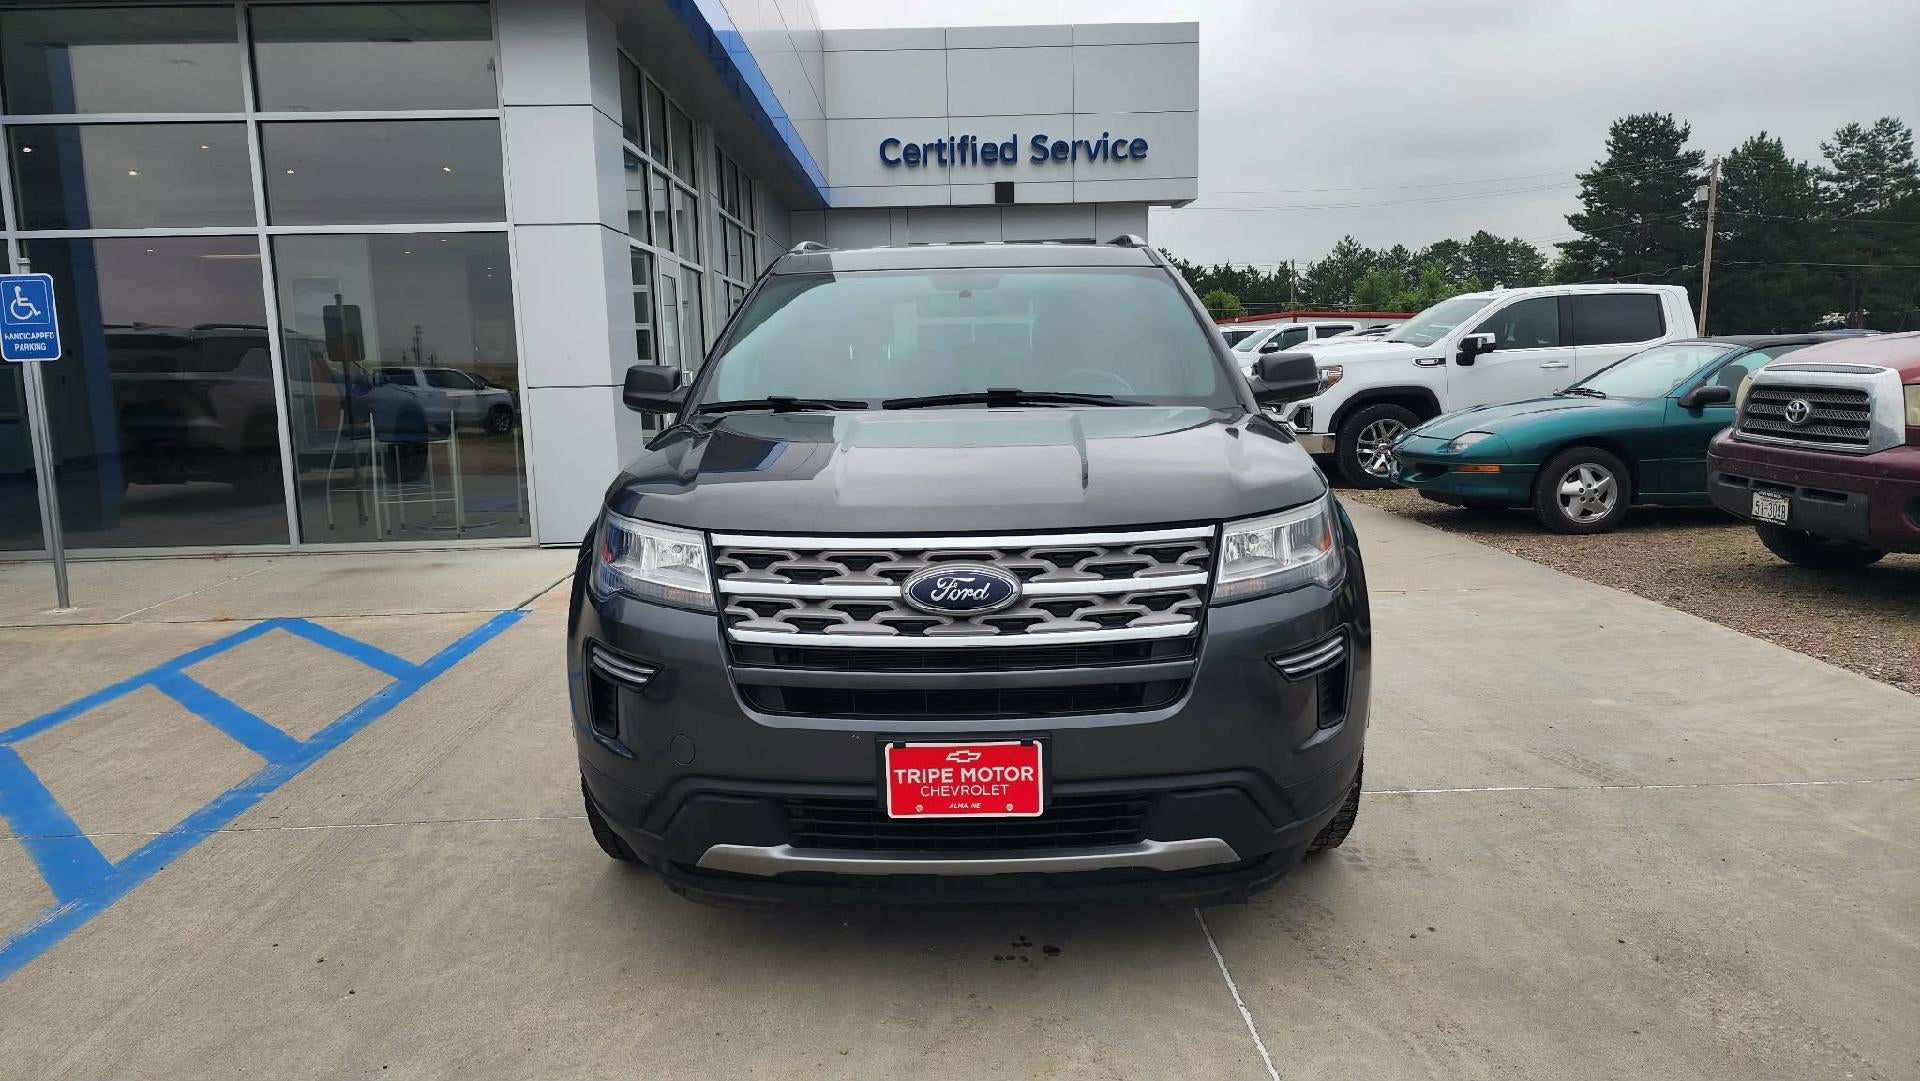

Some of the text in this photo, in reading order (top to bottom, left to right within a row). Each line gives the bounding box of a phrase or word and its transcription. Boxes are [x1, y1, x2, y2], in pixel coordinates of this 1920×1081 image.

[879, 132, 1149, 168] Certified Service
[5, 332, 55, 340] HANDICAPPED
[15, 343, 47, 351] PARKING
[930, 577, 991, 602] Ford
[894, 766, 1034, 784] TRIPE MOTOR
[920, 784, 1010, 797] CHEVROLET
